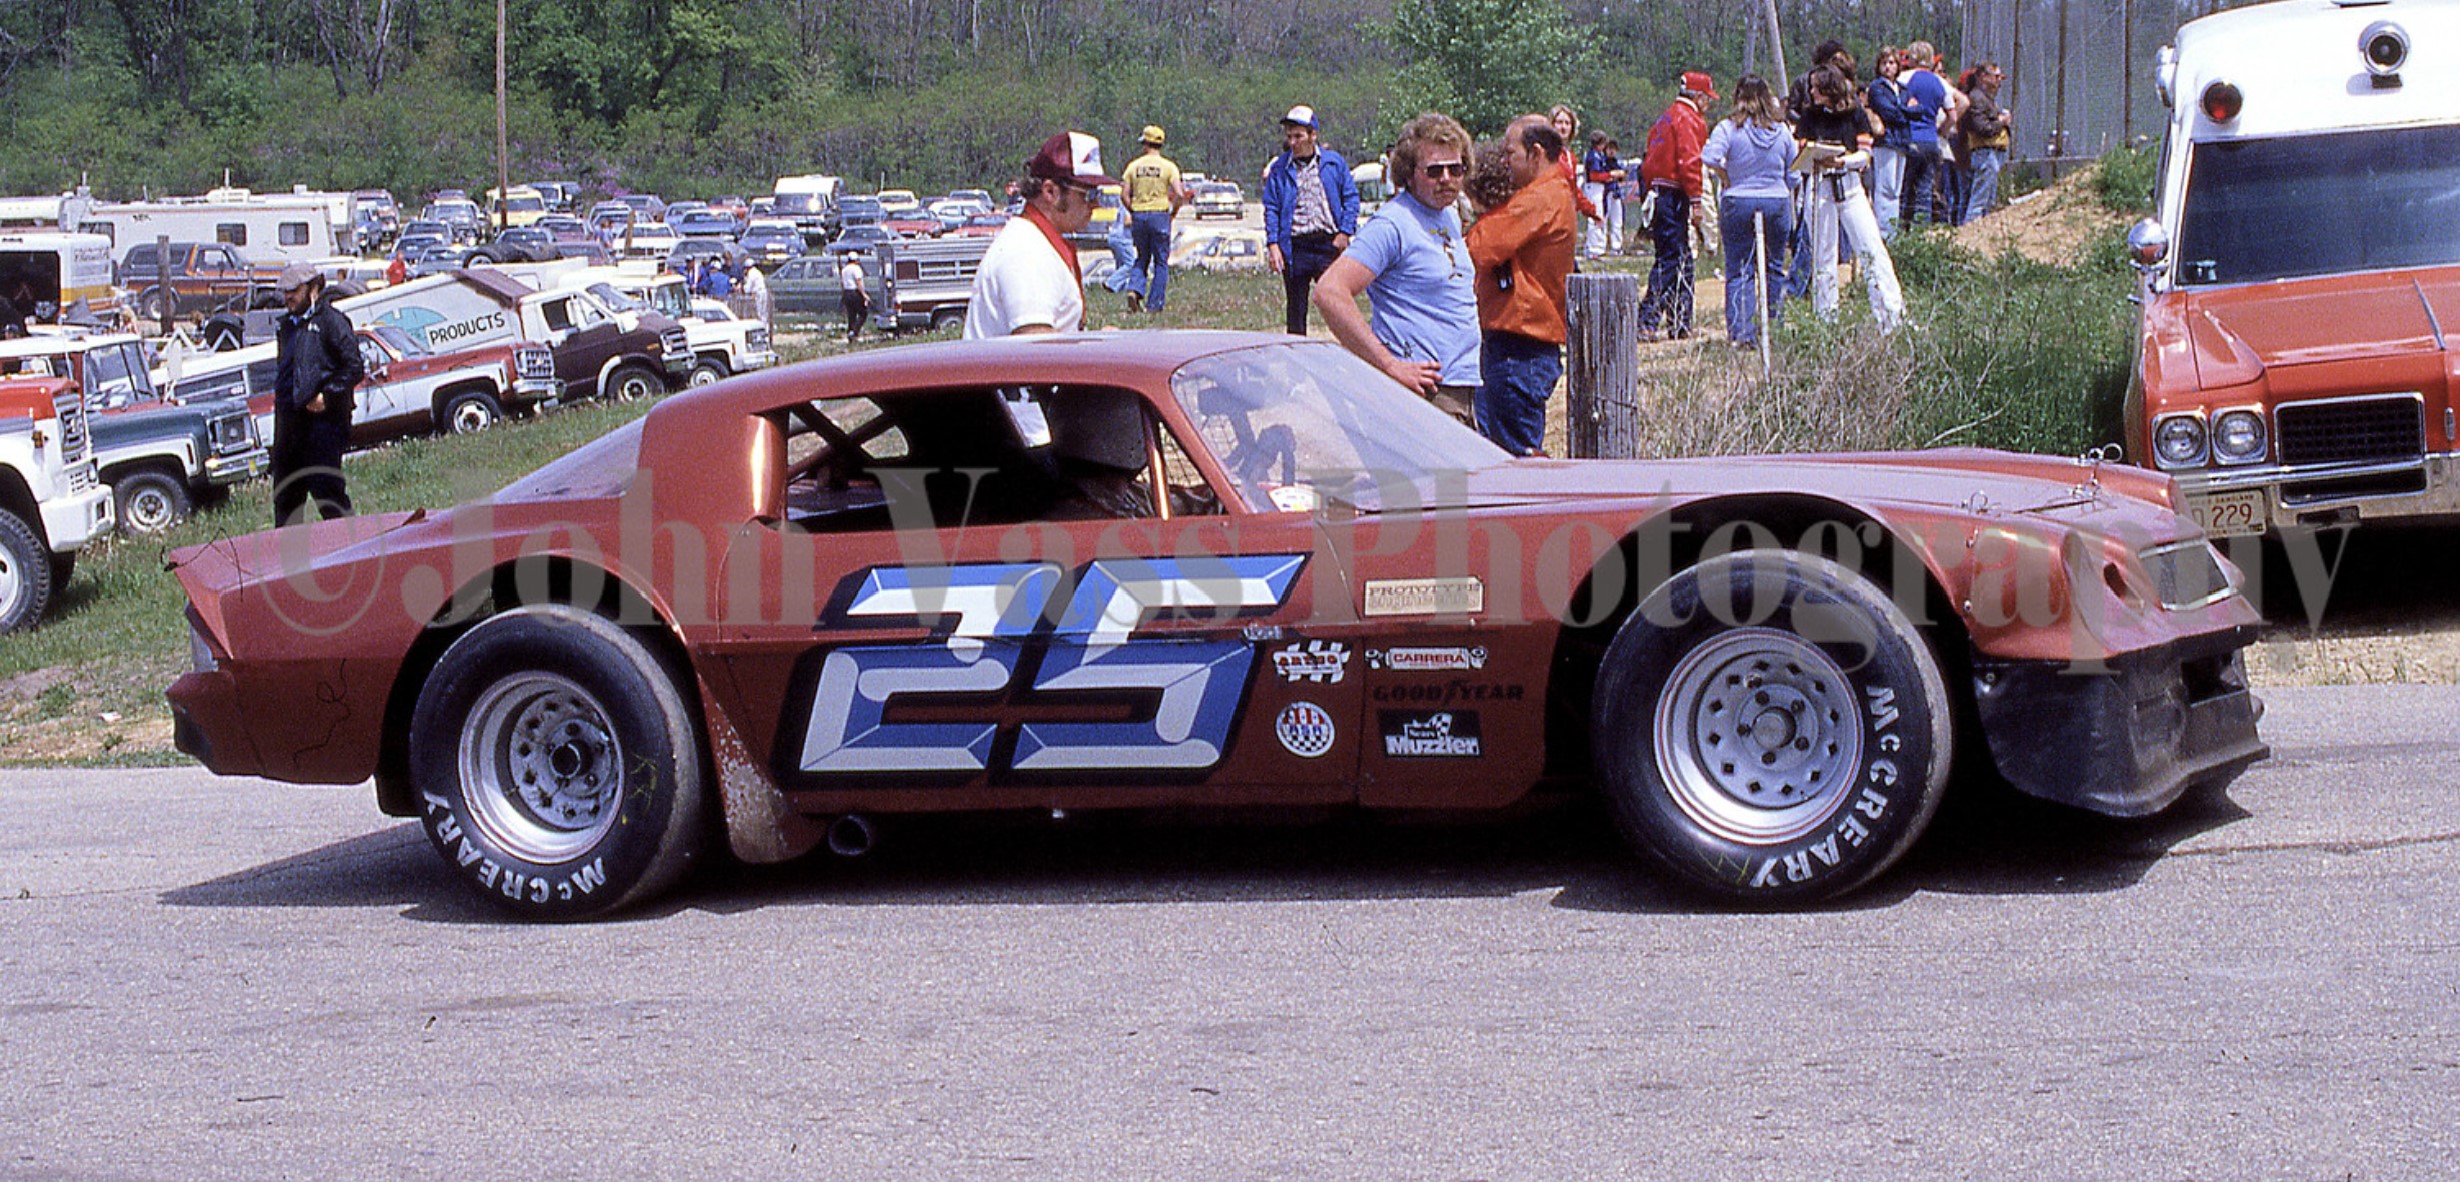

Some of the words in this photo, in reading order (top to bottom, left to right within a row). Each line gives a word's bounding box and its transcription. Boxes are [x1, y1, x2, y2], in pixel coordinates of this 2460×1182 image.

[428, 312, 506, 345] PRODUCTS
[2211, 503, 2252, 528] 229
[1368, 583, 1481, 597] PROTOTYPE
[790, 552, 1312, 780] 25
[1393, 653, 1466, 664] CARRERA
[1373, 680, 1524, 703] GOODYEAR
[1385, 735, 1480, 756] Muzzler
[1750, 686, 1900, 888] McCREARY
[422, 789, 607, 904] McCREARY
